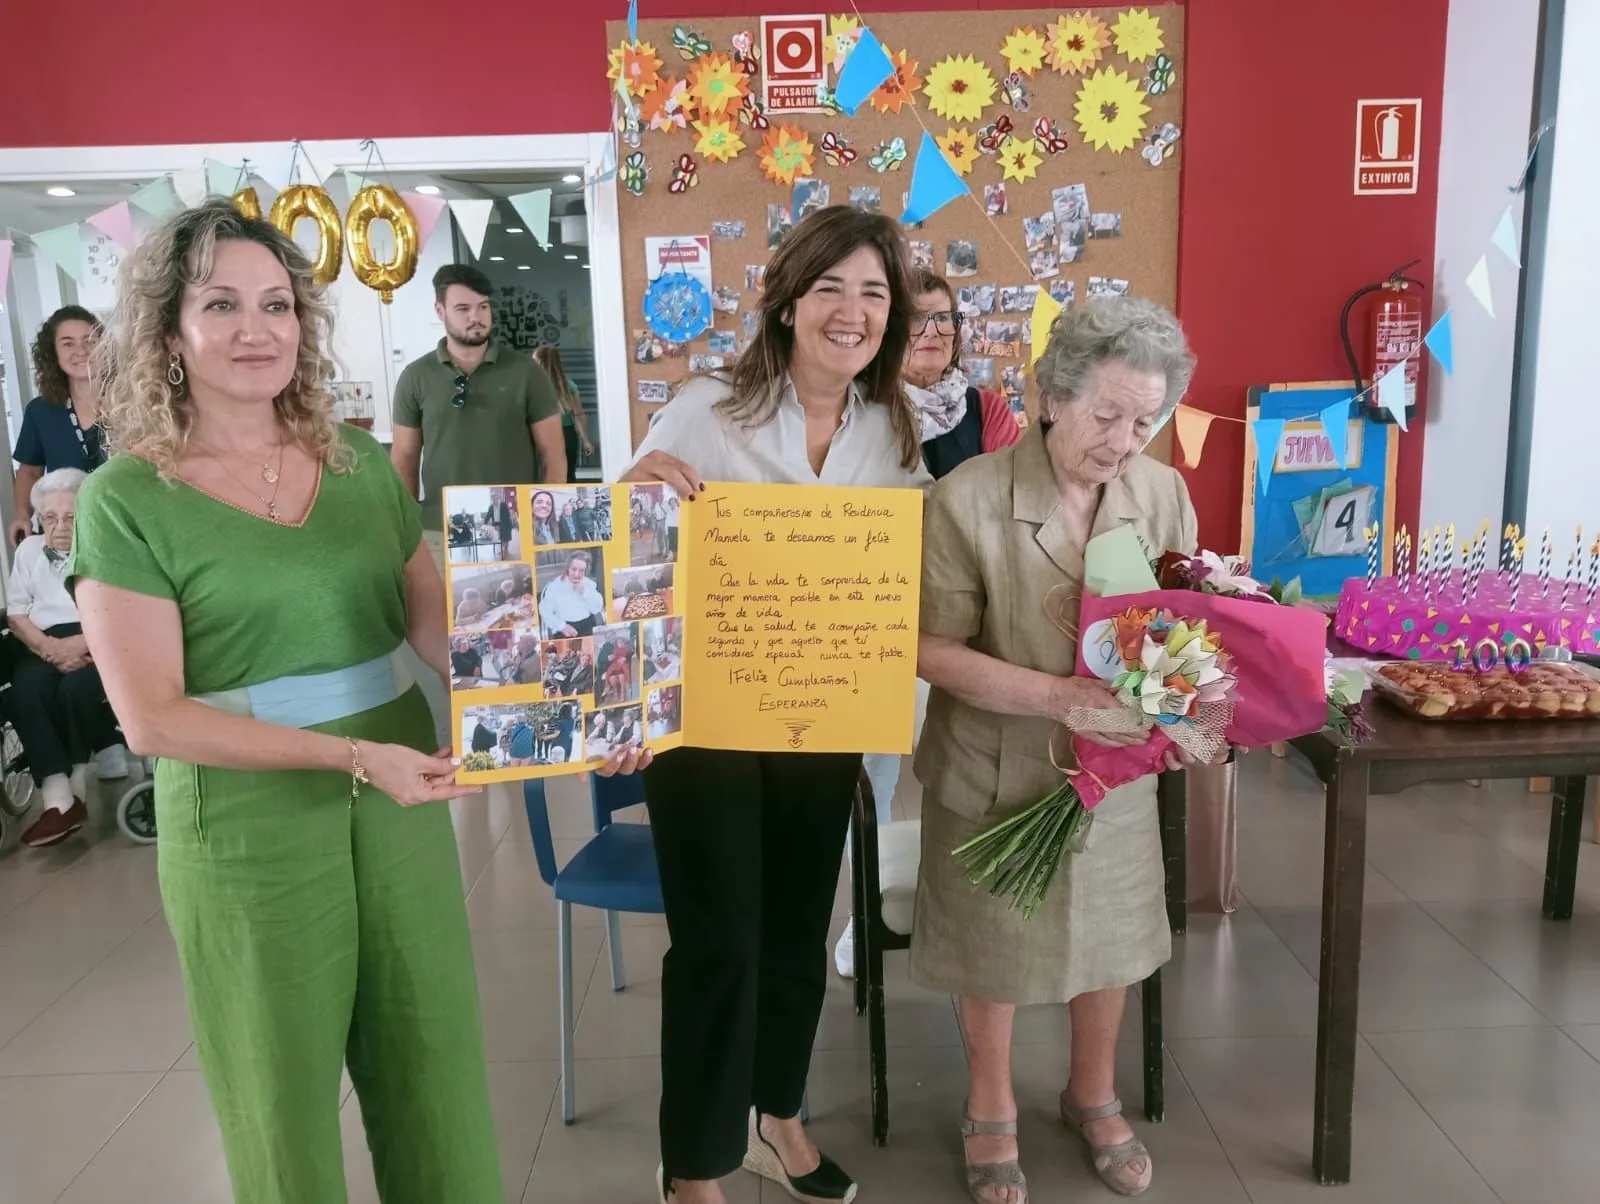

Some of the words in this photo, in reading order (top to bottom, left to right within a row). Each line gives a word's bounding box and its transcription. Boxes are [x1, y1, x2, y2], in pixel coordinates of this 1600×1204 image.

[771, 99, 783, 107] DE
[785, 97, 821, 107] ALARM
[1361, 172, 1411, 184] EXTINTOR
[708, 496, 732, 519] Tus
[821, 503, 833, 519] de
[1335, 499, 1357, 543] 4
[704, 527, 751, 543] Manuela
[763, 528, 776, 542] te
[786, 527, 836, 543] deseamos
[844, 534, 857, 543] un
[864, 529, 891, 552] feliz
[720, 572, 741, 588] Que
[748, 571, 759, 585] la
[766, 572, 789, 586] vida
[797, 572, 809, 587] te
[820, 573, 872, 589] sorprenda
[878, 571, 889, 585] de
[896, 571, 909, 585] la
[706, 592, 735, 608] mejor
[742, 594, 781, 603] manera
[790, 591, 821, 607] posible
[829, 593, 840, 602] en
[847, 590, 865, 601] este
[874, 593, 902, 603] nuevo
[736, 607, 747, 618] de
[718, 620, 739, 633] Que
[743, 623, 755, 632] la
[763, 618, 797, 632] salud
[804, 620, 817, 632] te
[828, 621, 878, 635] acompañe
[885, 617, 909, 632] cada
[707, 635, 745, 648] segundo
[753, 639, 760, 649] y
[767, 637, 784, 649] que
[790, 635, 824, 649] aquello
[831, 637, 848, 651] que
[854, 634, 868, 646] tú
[706, 648, 755, 659] consideres
[765, 650, 805, 664] especial
[820, 652, 853, 661] nunca
[858, 649, 872, 659] te
[1450, 637, 1532, 672] 100
[777, 665, 860, 694] Cumpleaños!
